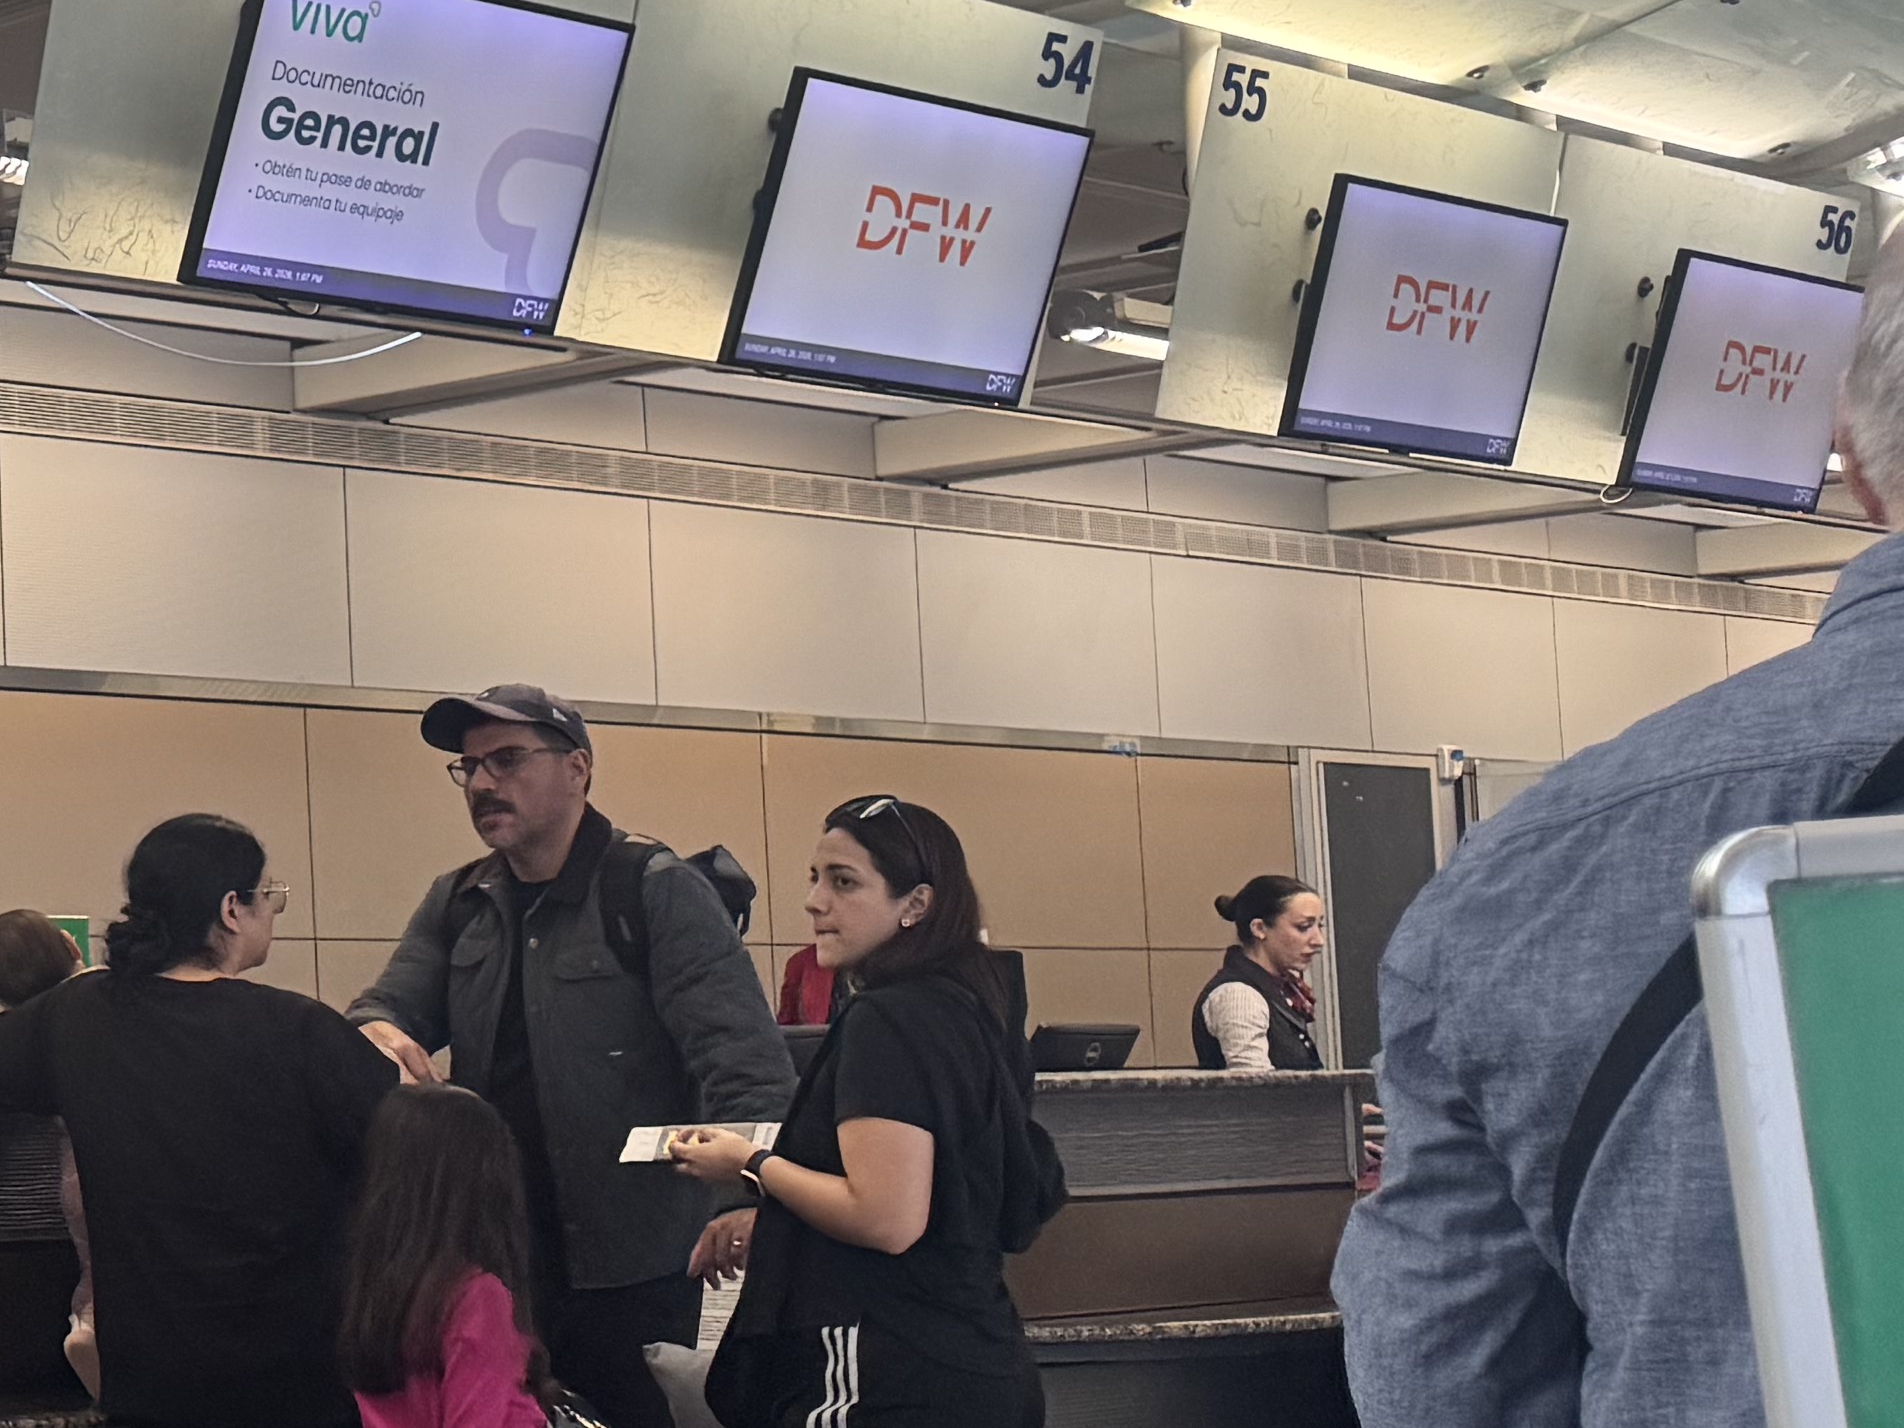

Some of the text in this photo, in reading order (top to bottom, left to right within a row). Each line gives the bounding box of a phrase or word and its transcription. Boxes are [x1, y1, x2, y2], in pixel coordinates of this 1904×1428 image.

[271, 60, 425, 108] Documentación
[1037, 31, 1093, 94] 54
[1218, 64, 1269, 122] 55
[261, 96, 440, 167] General
[255, 185, 404, 224] Documenta tu equipaje
[261, 159, 425, 199] Obtén tu pase de abordar
[856, 184, 992, 267] DFW
[1815, 205, 1856, 254] 56
[512, 297, 549, 320] DFW
[1385, 274, 1491, 344] DFW
[1715, 340, 1807, 403] DFW
